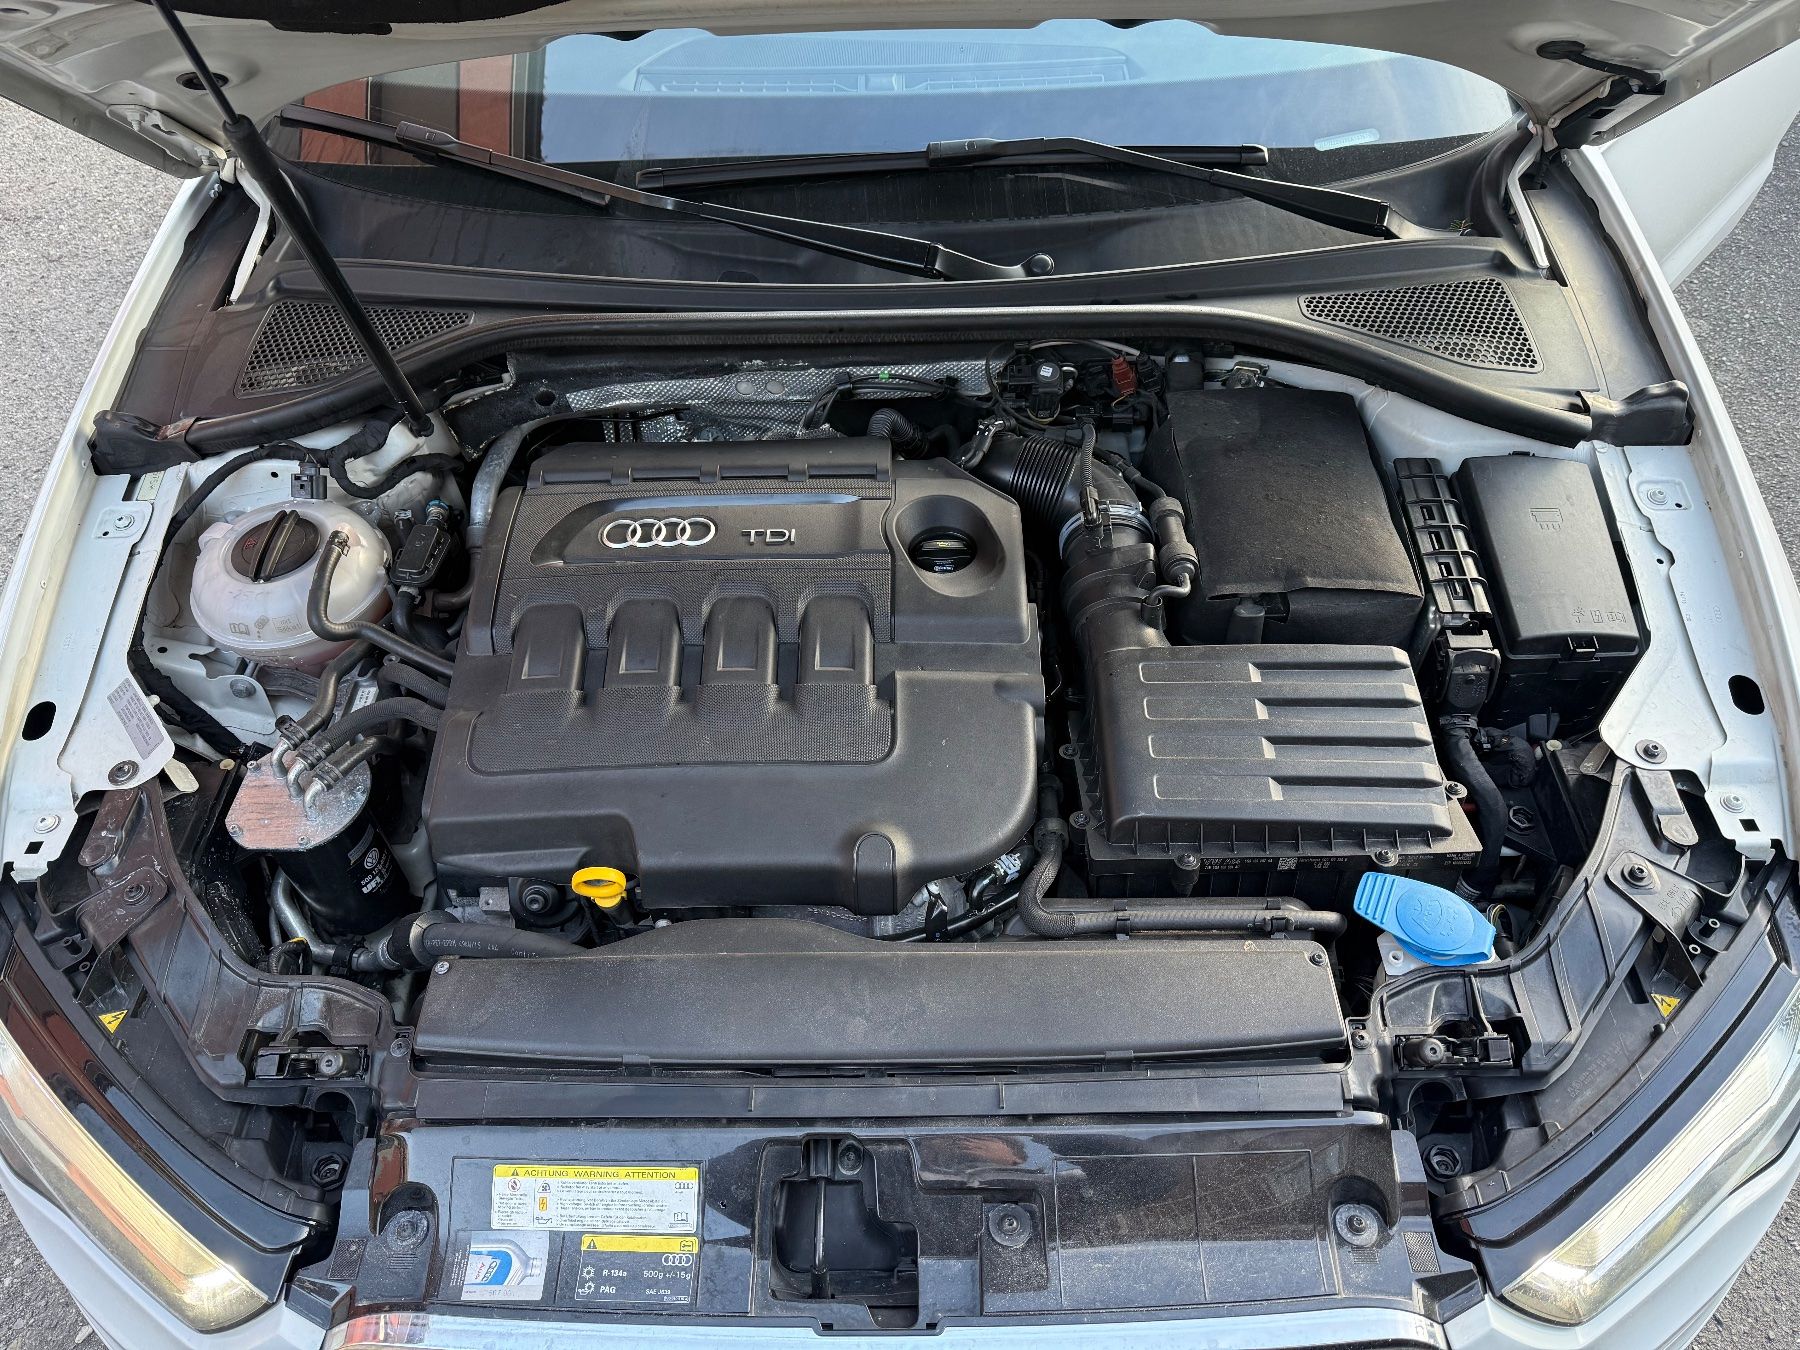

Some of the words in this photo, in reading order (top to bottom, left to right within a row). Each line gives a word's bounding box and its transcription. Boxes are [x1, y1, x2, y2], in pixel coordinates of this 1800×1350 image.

[741, 528, 796, 544] TDI
[523, 1169, 569, 1177] ACHTUNG
[573, 1170, 620, 1178] WARNING
[624, 1171, 676, 1179] ATTENTION
[602, 1269, 628, 1277] R-134a
[643, 1270, 664, 1279] 500g
[600, 1286, 616, 1294] PAG
